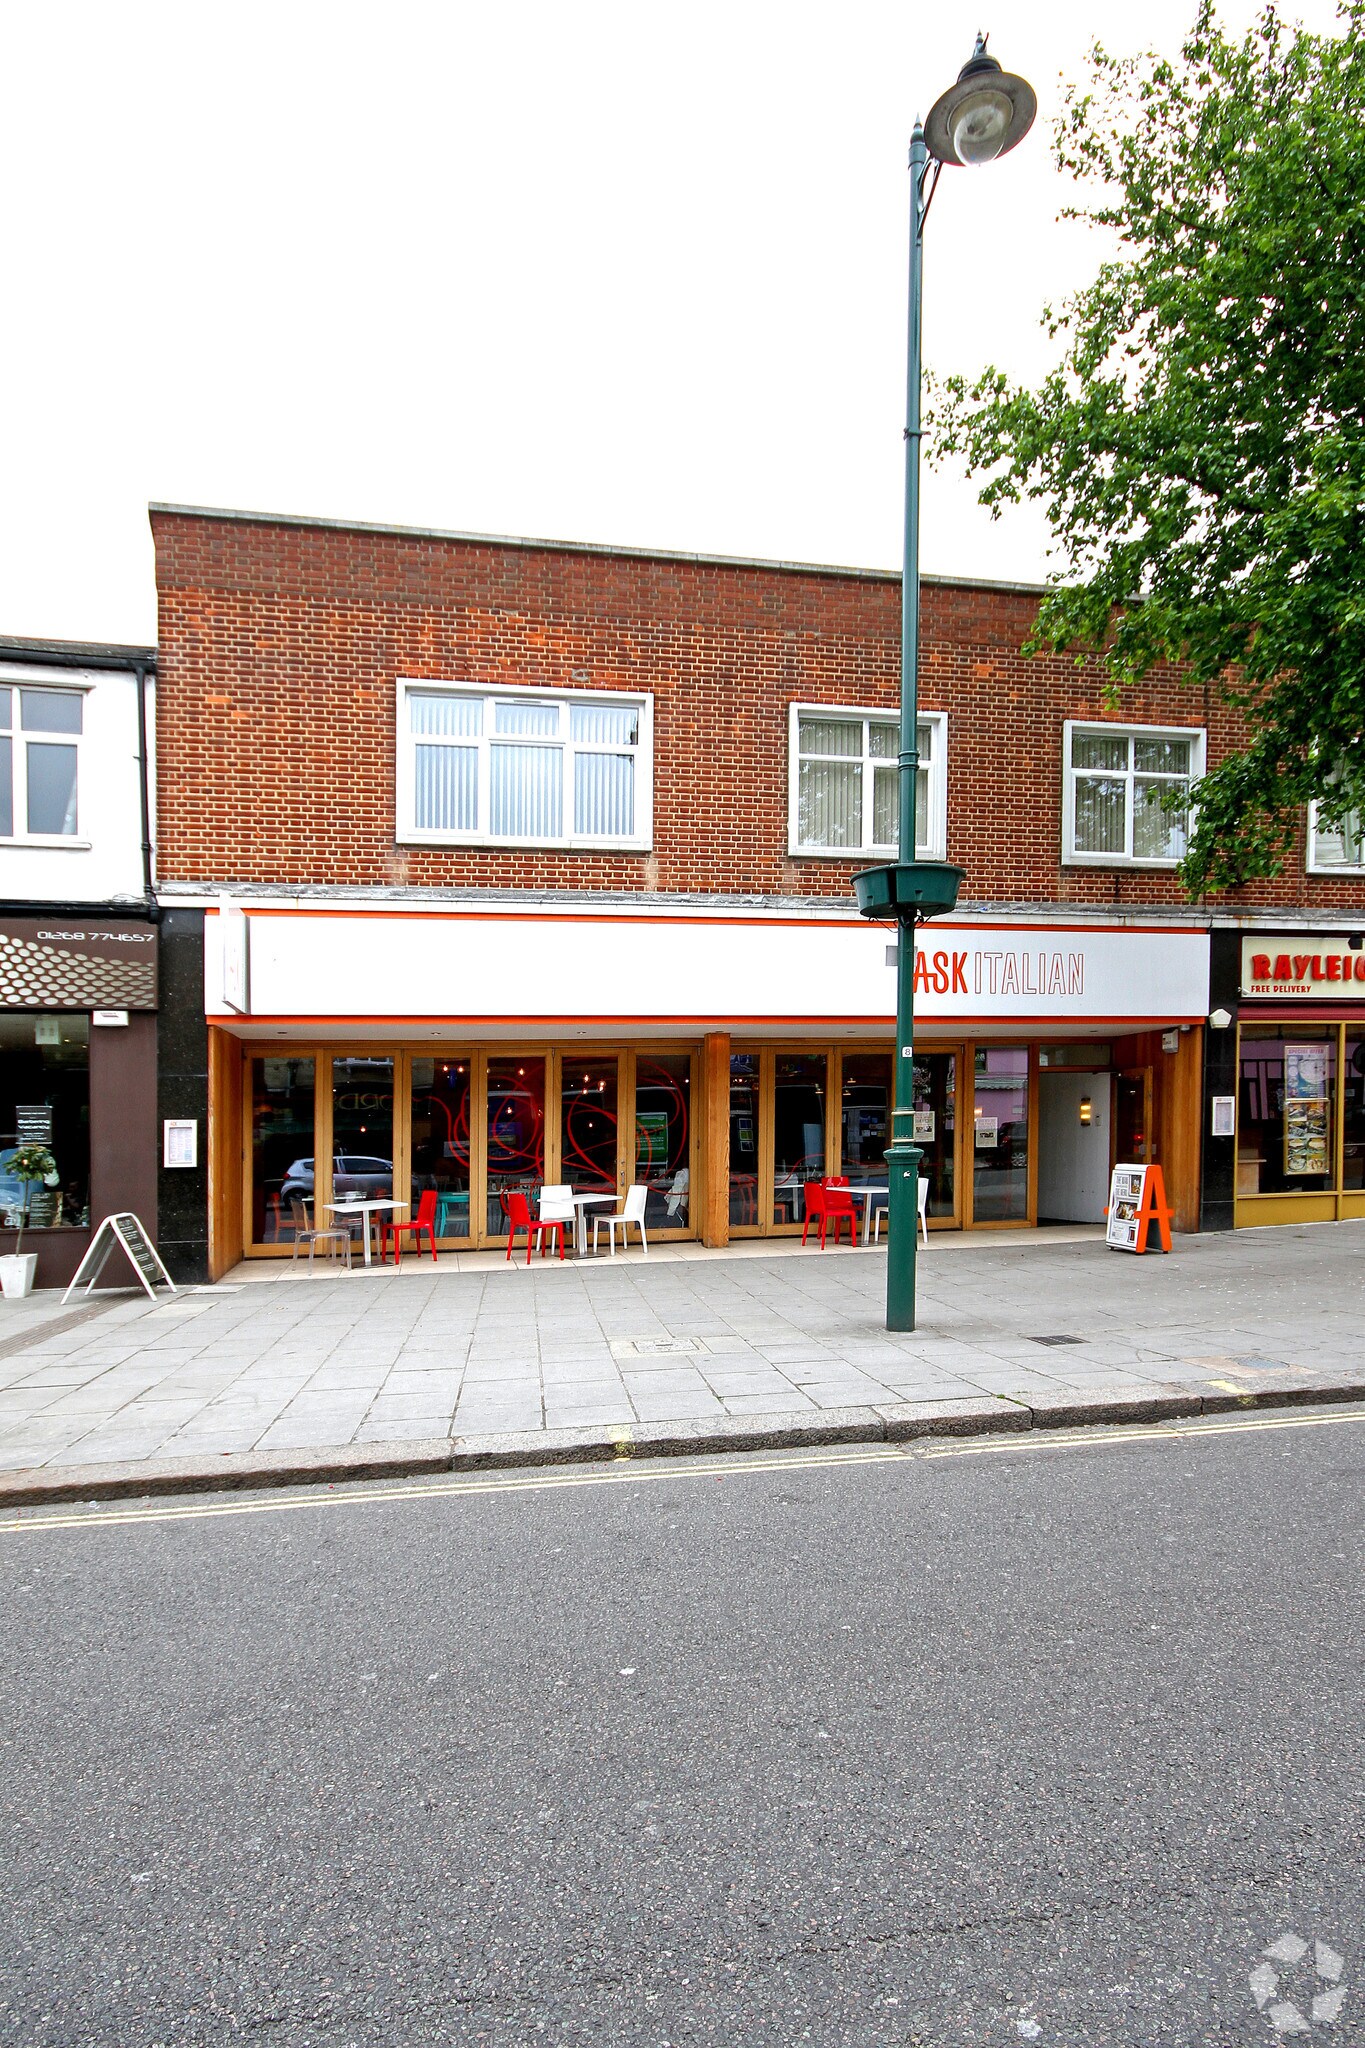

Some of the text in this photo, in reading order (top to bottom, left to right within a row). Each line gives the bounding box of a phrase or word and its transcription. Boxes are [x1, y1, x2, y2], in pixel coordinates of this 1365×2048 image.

[36, 931, 155, 942] 01268 774657
[913, 951, 1084, 995] ASK ITALIAN
[1251, 985, 1312, 993] FREE DELIVERY
[904, 1048, 911, 1056] 8
